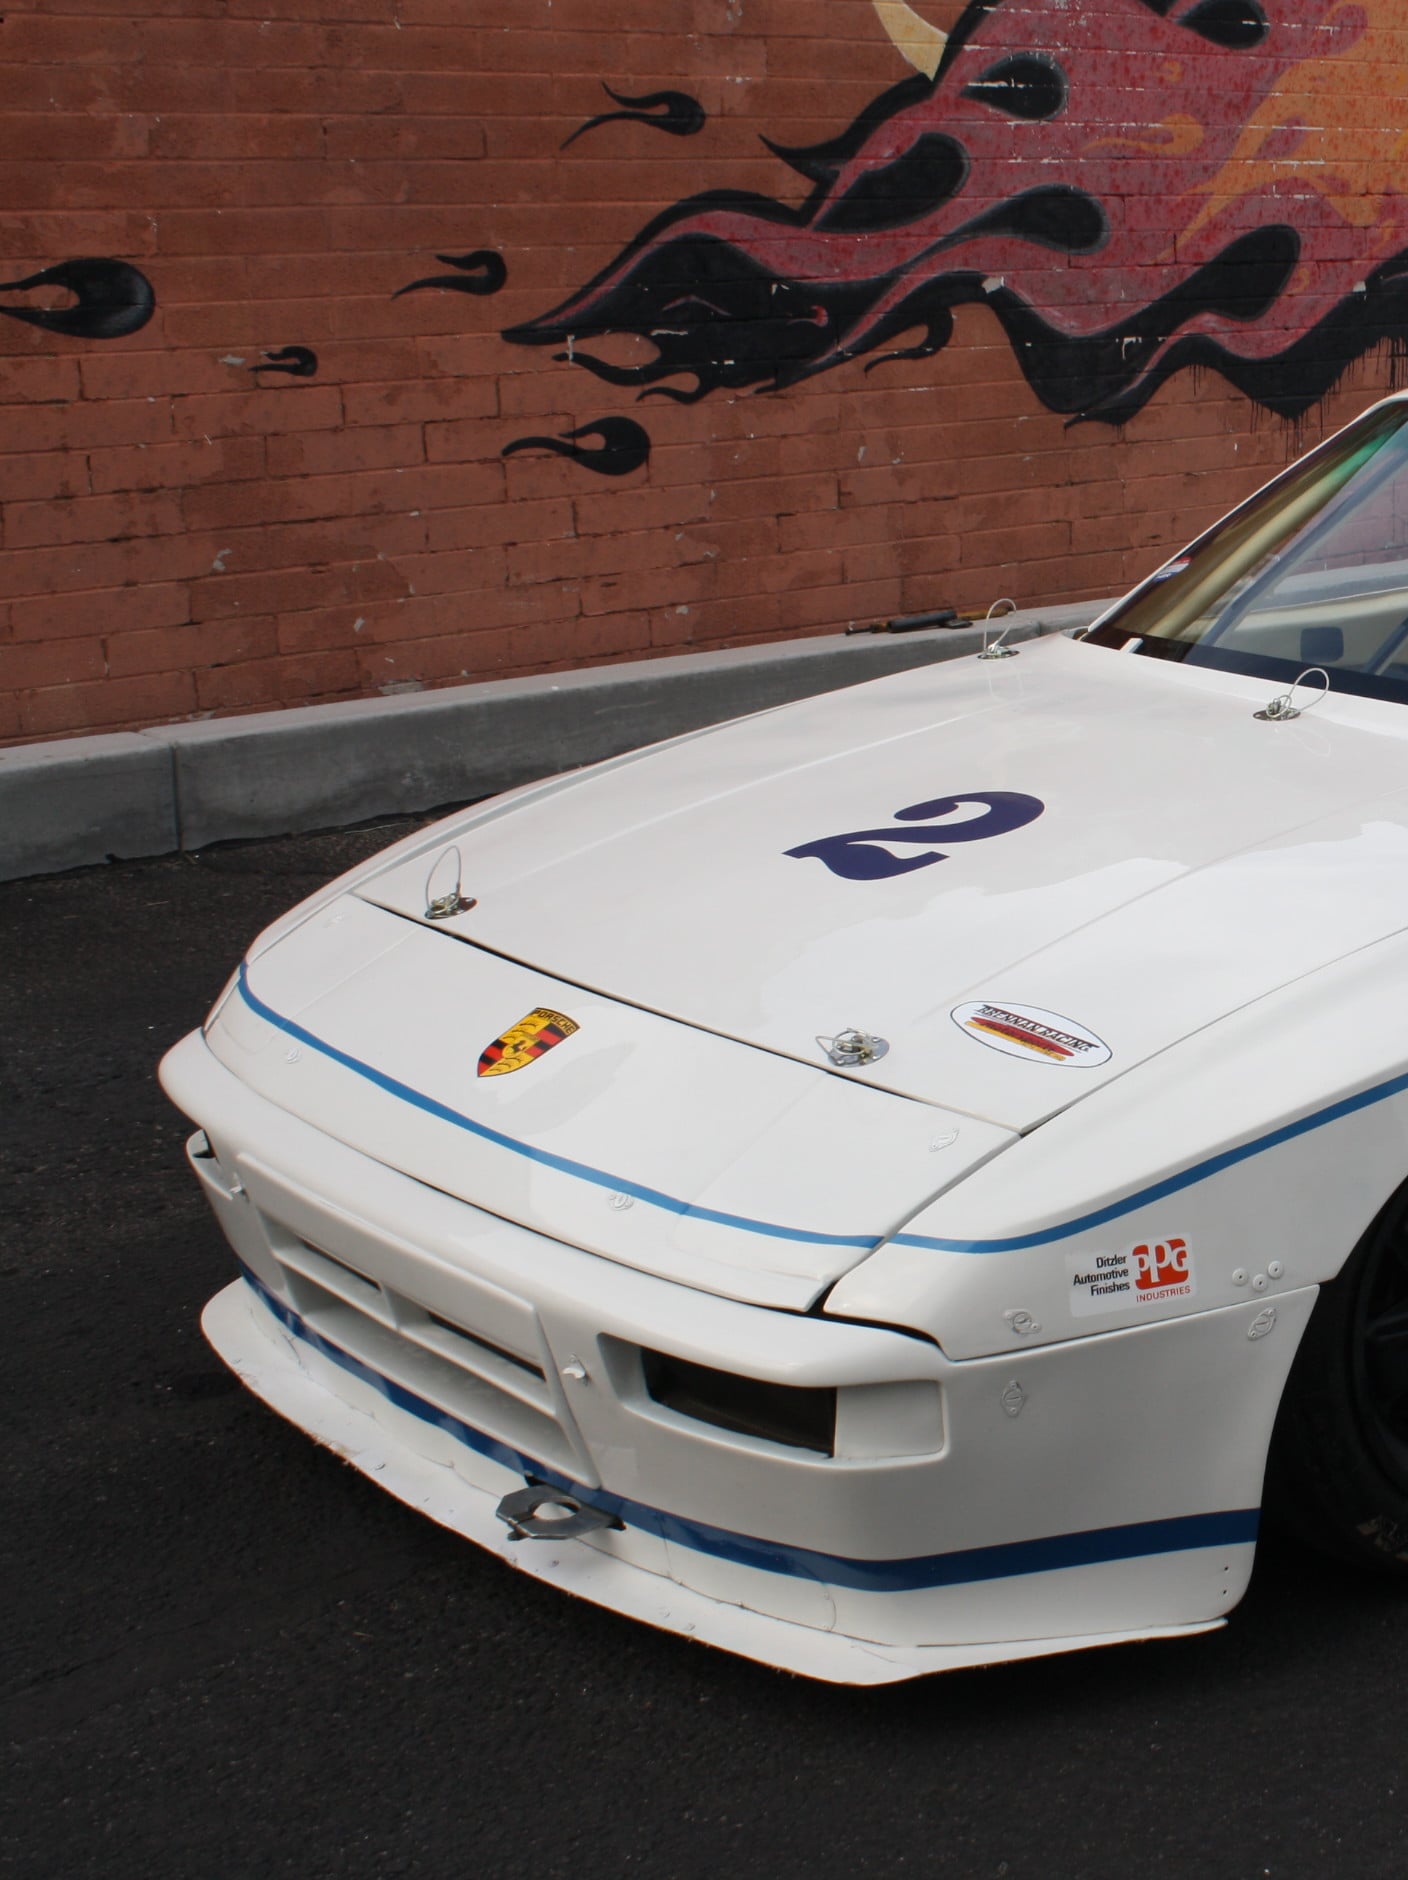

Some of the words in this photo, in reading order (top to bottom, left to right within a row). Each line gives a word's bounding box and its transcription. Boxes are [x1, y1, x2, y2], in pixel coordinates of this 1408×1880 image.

[781, 791, 1045, 881] 2
[534, 1009, 576, 1035] PORSCHE
[1096, 1254, 1127, 1269] Ditzler
[1073, 1267, 1129, 1286] Automotive
[1090, 1281, 1131, 1297] Finishes
[1136, 1285, 1191, 1303] INDUSTRIES
